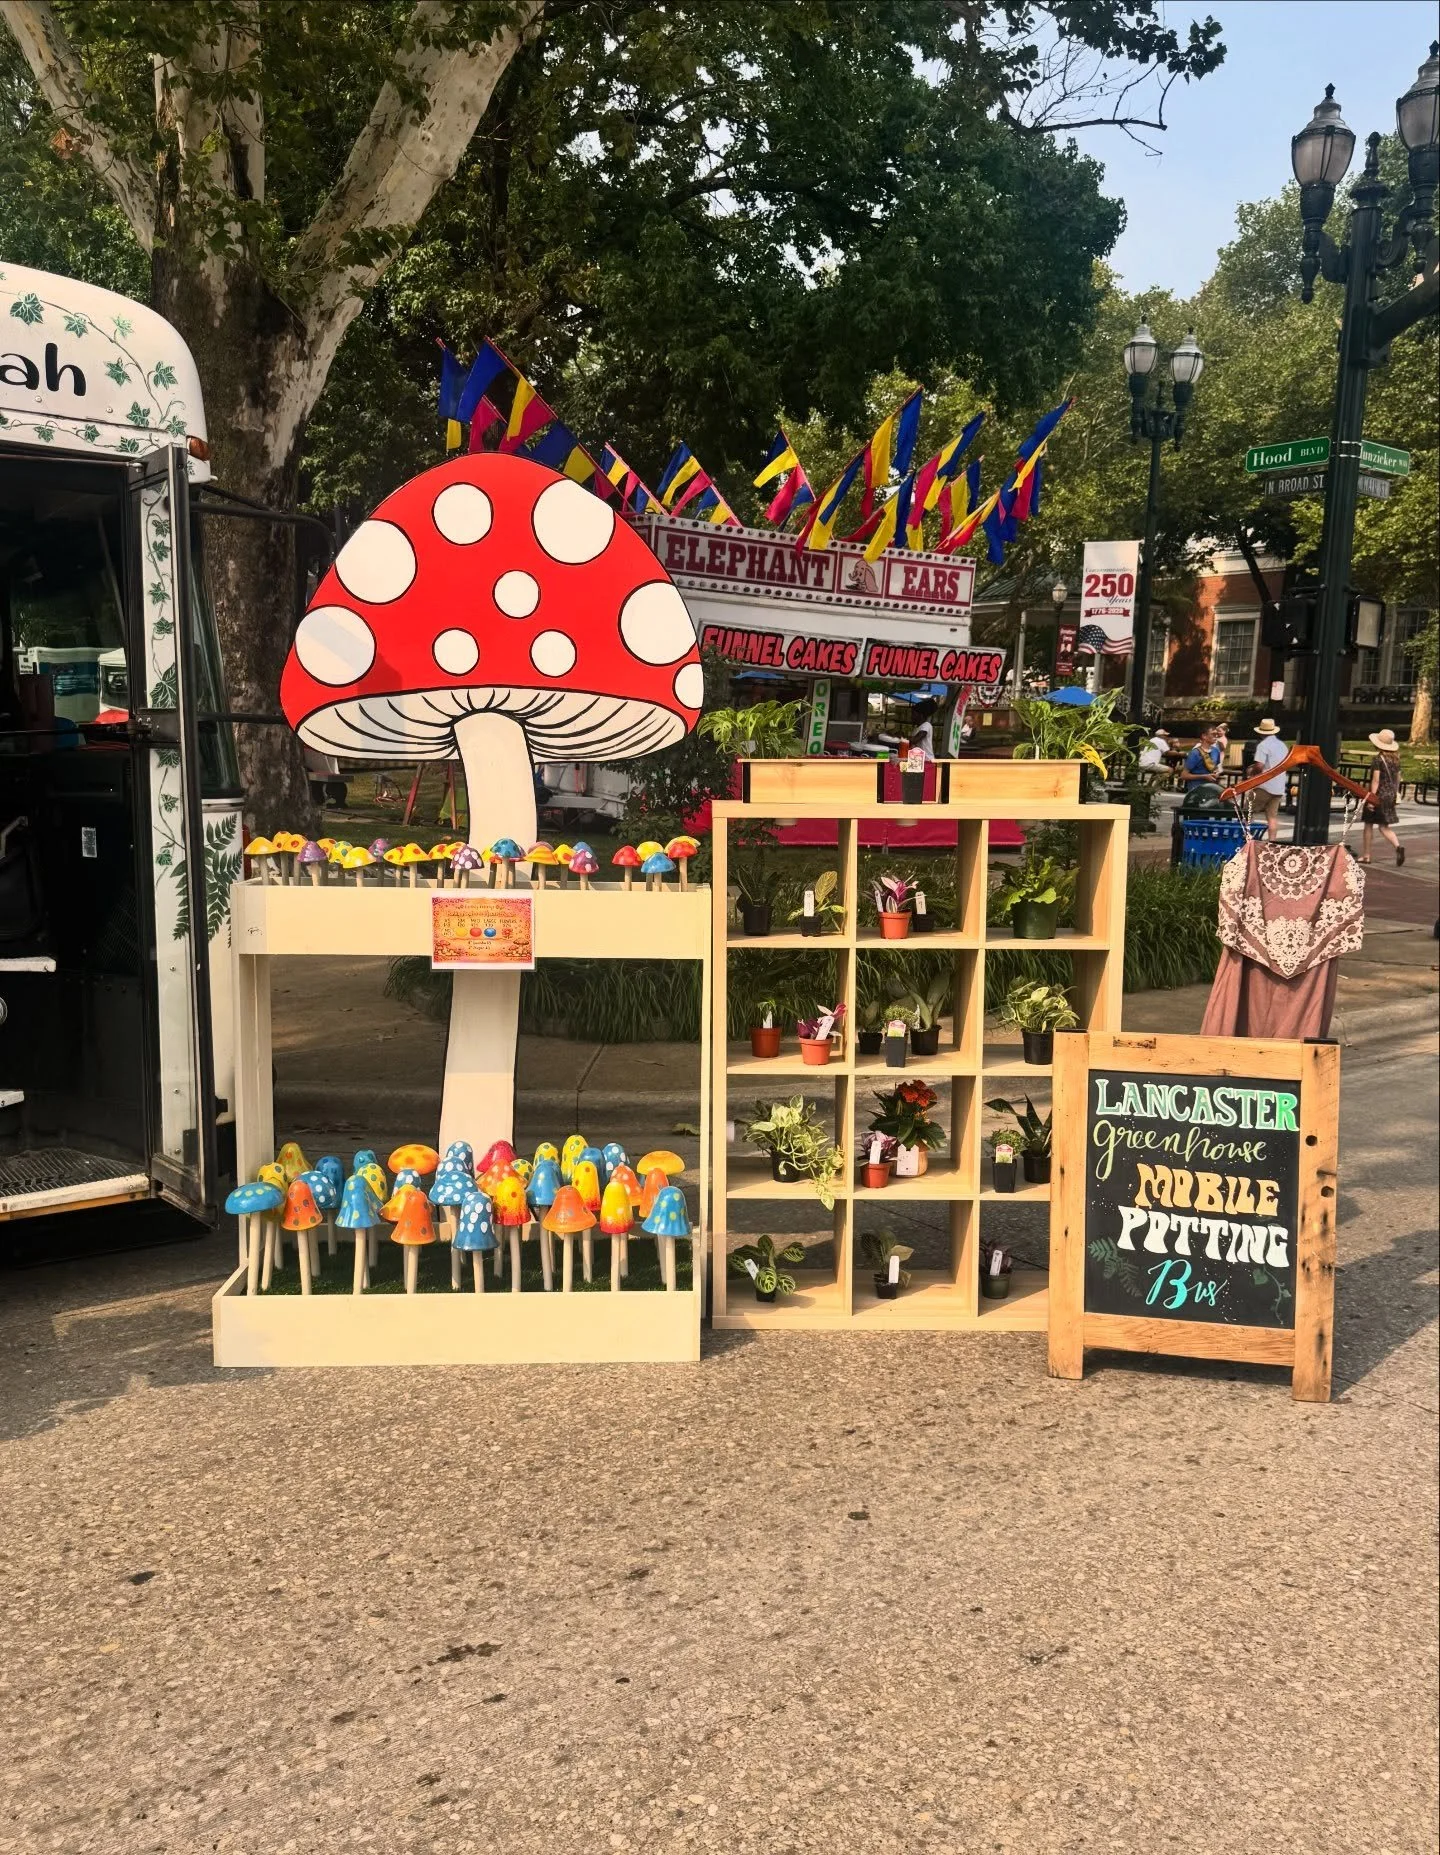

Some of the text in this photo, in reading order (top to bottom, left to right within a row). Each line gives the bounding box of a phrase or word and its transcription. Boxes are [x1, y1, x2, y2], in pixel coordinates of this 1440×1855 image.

[1252, 446, 1324, 467] Hood BLVD
[1268, 474, 1325, 495] N BROAD ST
[664, 533, 961, 602] ELEPHANT EARS
[1085, 573, 1134, 597] 250
[1106, 595, 1132, 606] Years
[701, 625, 858, 675] FUNNEL CAKES
[866, 645, 1001, 683] FUNNEL CAKES
[1095, 1078, 1300, 1132] LANCASTER
[1134, 1163, 1281, 1217] MOBILE
[1116, 1204, 1290, 1268] POTTING
[1145, 1258, 1228, 1310] Bus
